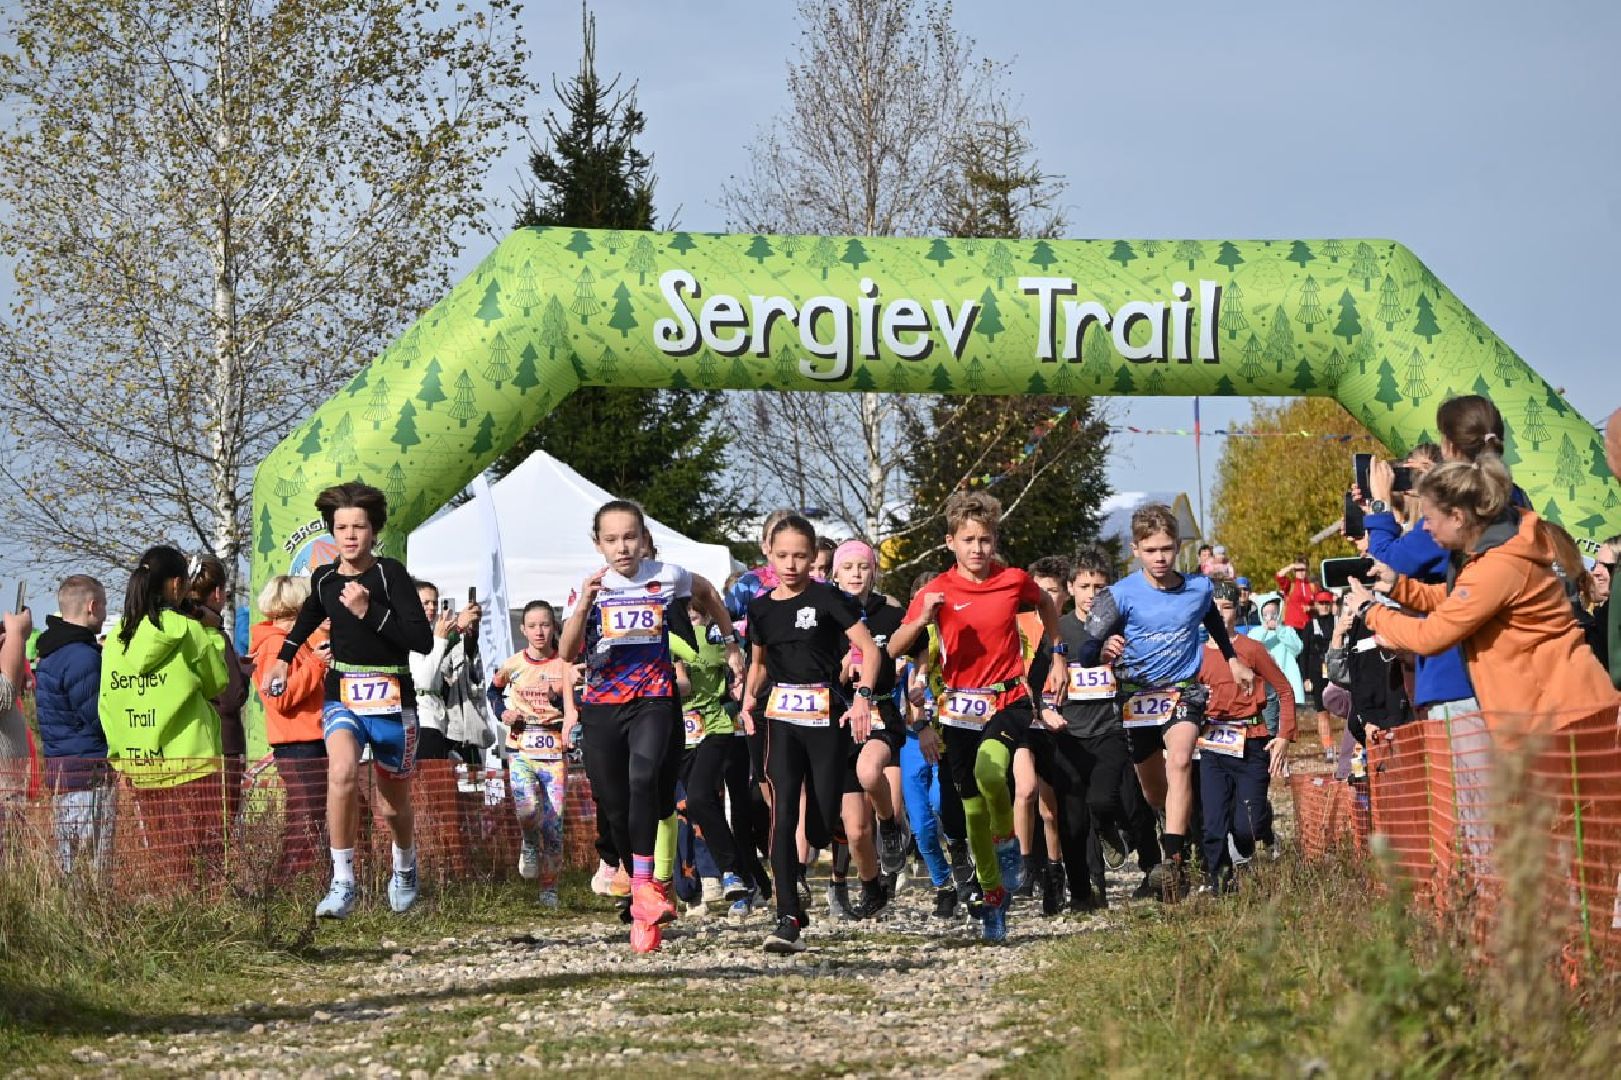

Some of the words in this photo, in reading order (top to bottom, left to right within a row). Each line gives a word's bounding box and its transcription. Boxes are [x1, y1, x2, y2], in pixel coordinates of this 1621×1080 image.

[653, 269, 981, 382] Sergiev
[1018, 277, 1223, 364] Trail
[283, 517, 327, 554] SERGI
[614, 610, 654, 630] 178
[110, 670, 168, 696] Sergiev
[1075, 671, 1110, 687] 151
[351, 681, 389, 701] 177
[777, 694, 819, 712] 121
[948, 696, 987, 717] 179
[1133, 697, 1171, 715] 126
[125, 708, 156, 729] Trail
[125, 747, 165, 768] TEAM
